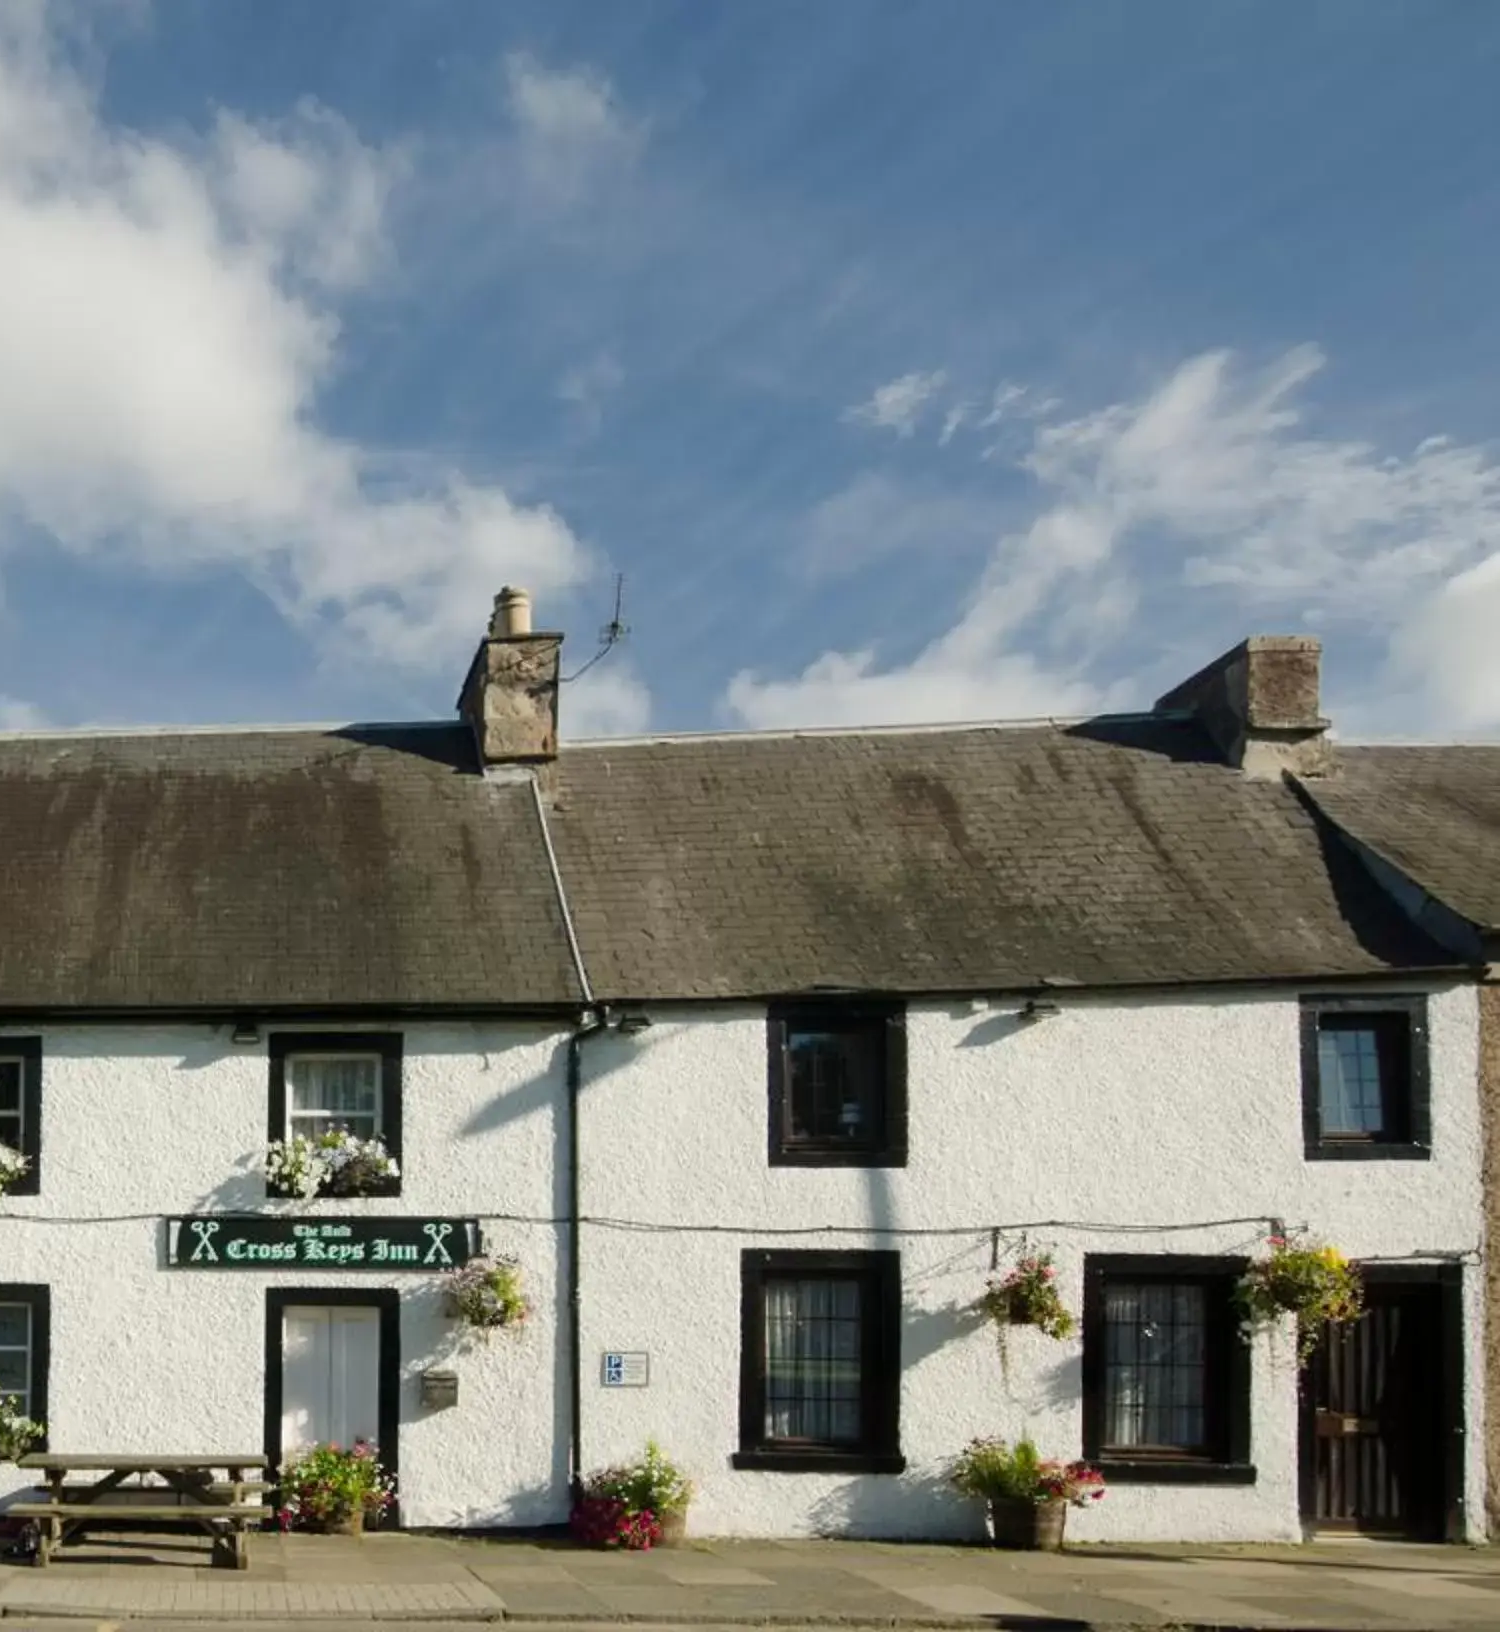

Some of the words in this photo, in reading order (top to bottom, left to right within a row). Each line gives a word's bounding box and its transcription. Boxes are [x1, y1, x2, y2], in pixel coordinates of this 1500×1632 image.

[293, 1224, 318, 1236] The
[321, 1224, 351, 1236] Auld
[227, 1238, 297, 1259] Cross
[303, 1239, 365, 1264] Keys
[371, 1239, 418, 1260] Inn
